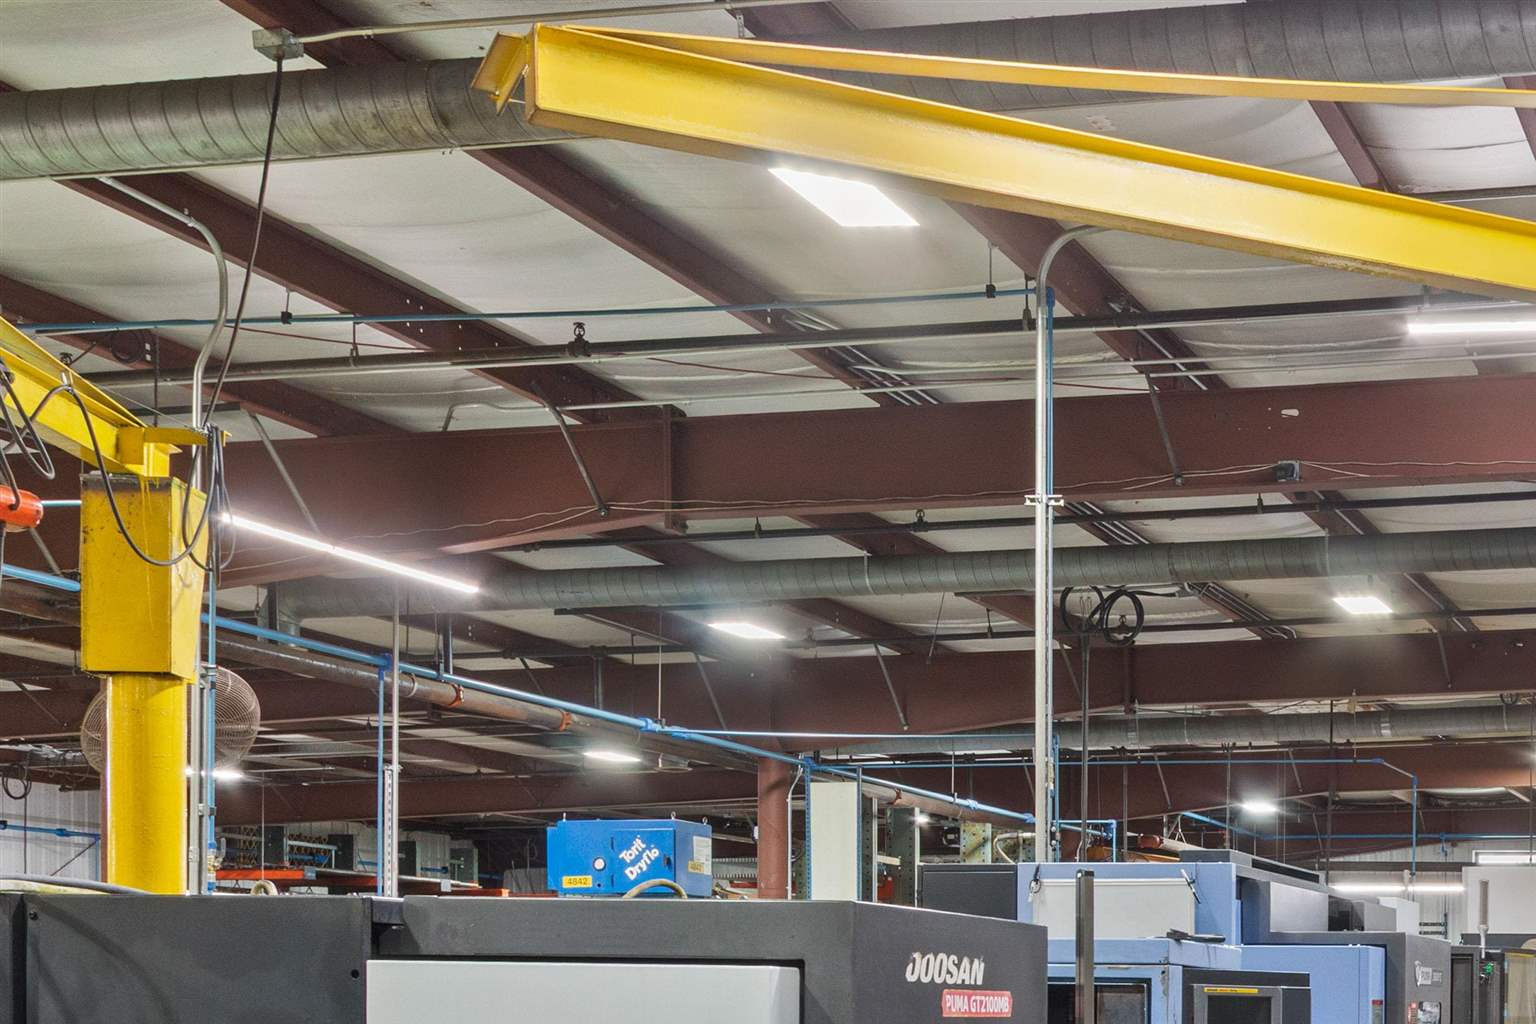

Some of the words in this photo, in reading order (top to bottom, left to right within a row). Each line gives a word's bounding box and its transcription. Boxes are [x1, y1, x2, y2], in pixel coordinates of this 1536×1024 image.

[619, 836, 646, 863] Torit
[625, 846, 660, 880] Dryflo
[567, 877, 588, 886] 4842
[905, 952, 985, 986] DOOSAN
[945, 995, 969, 1012] PUMA
[970, 996, 1009, 1013] GT2100MB
